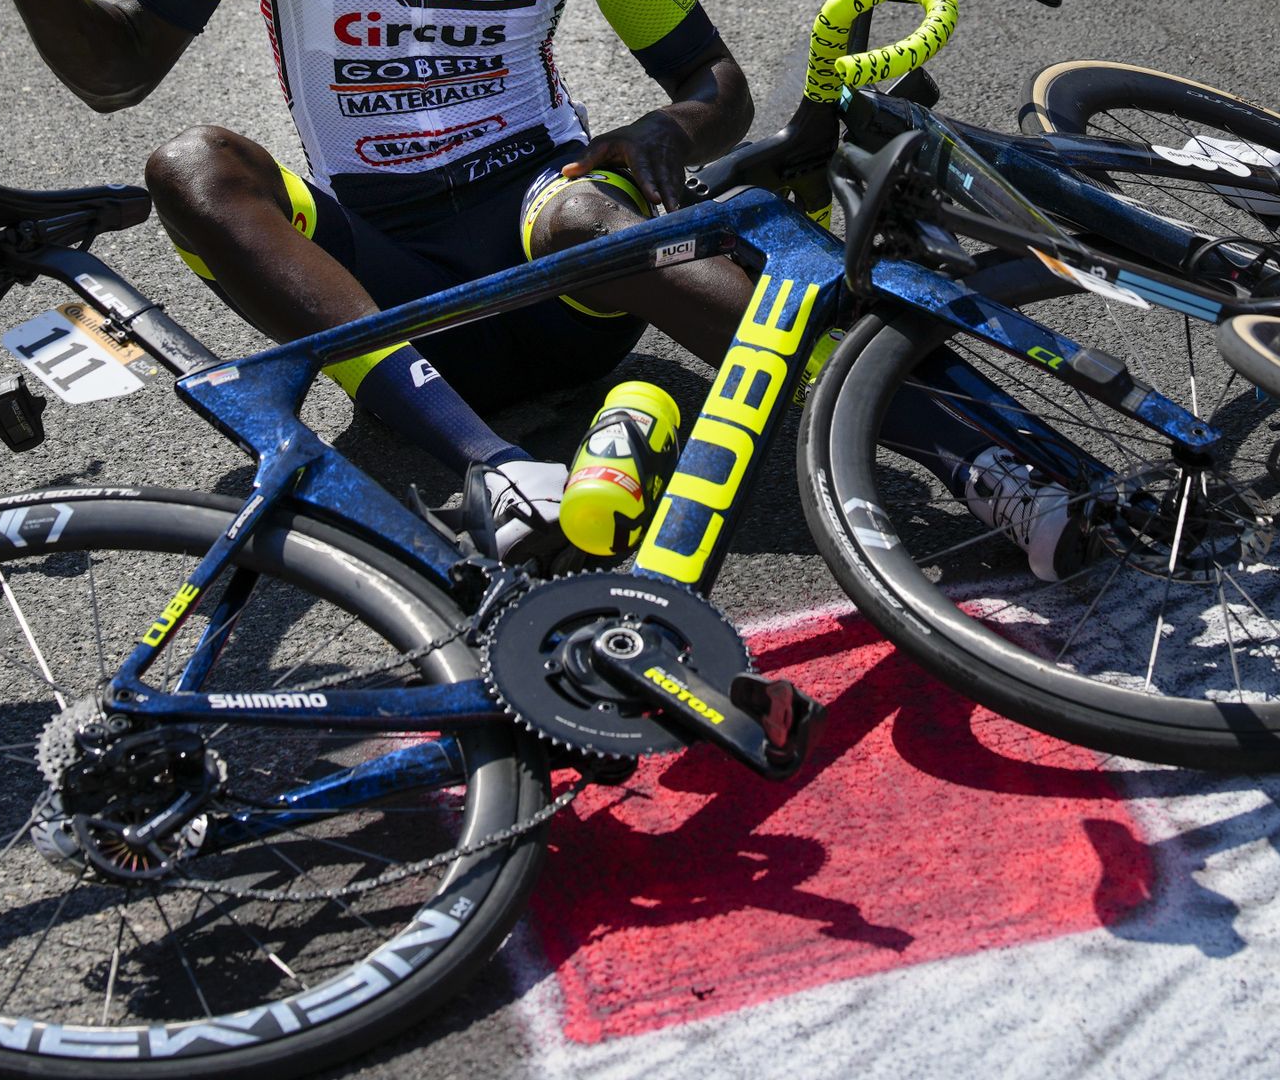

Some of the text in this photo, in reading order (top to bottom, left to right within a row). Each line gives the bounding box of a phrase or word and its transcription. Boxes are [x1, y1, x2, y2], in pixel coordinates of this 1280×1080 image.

[333, 11, 507, 47] Circus
[340, 55, 505, 81] GOBERT
[346, 80, 498, 115] MATERIAUX
[73, 272, 144, 326] CUB
[15, 326, 108, 392] 111
[633, 273, 821, 584] CUBE
[142, 581, 201, 648] CUBE
[609, 587, 669, 607] ROTOR
[207, 692, 329, 710] SHIMANO
[643, 667, 725, 725] ROTOR
